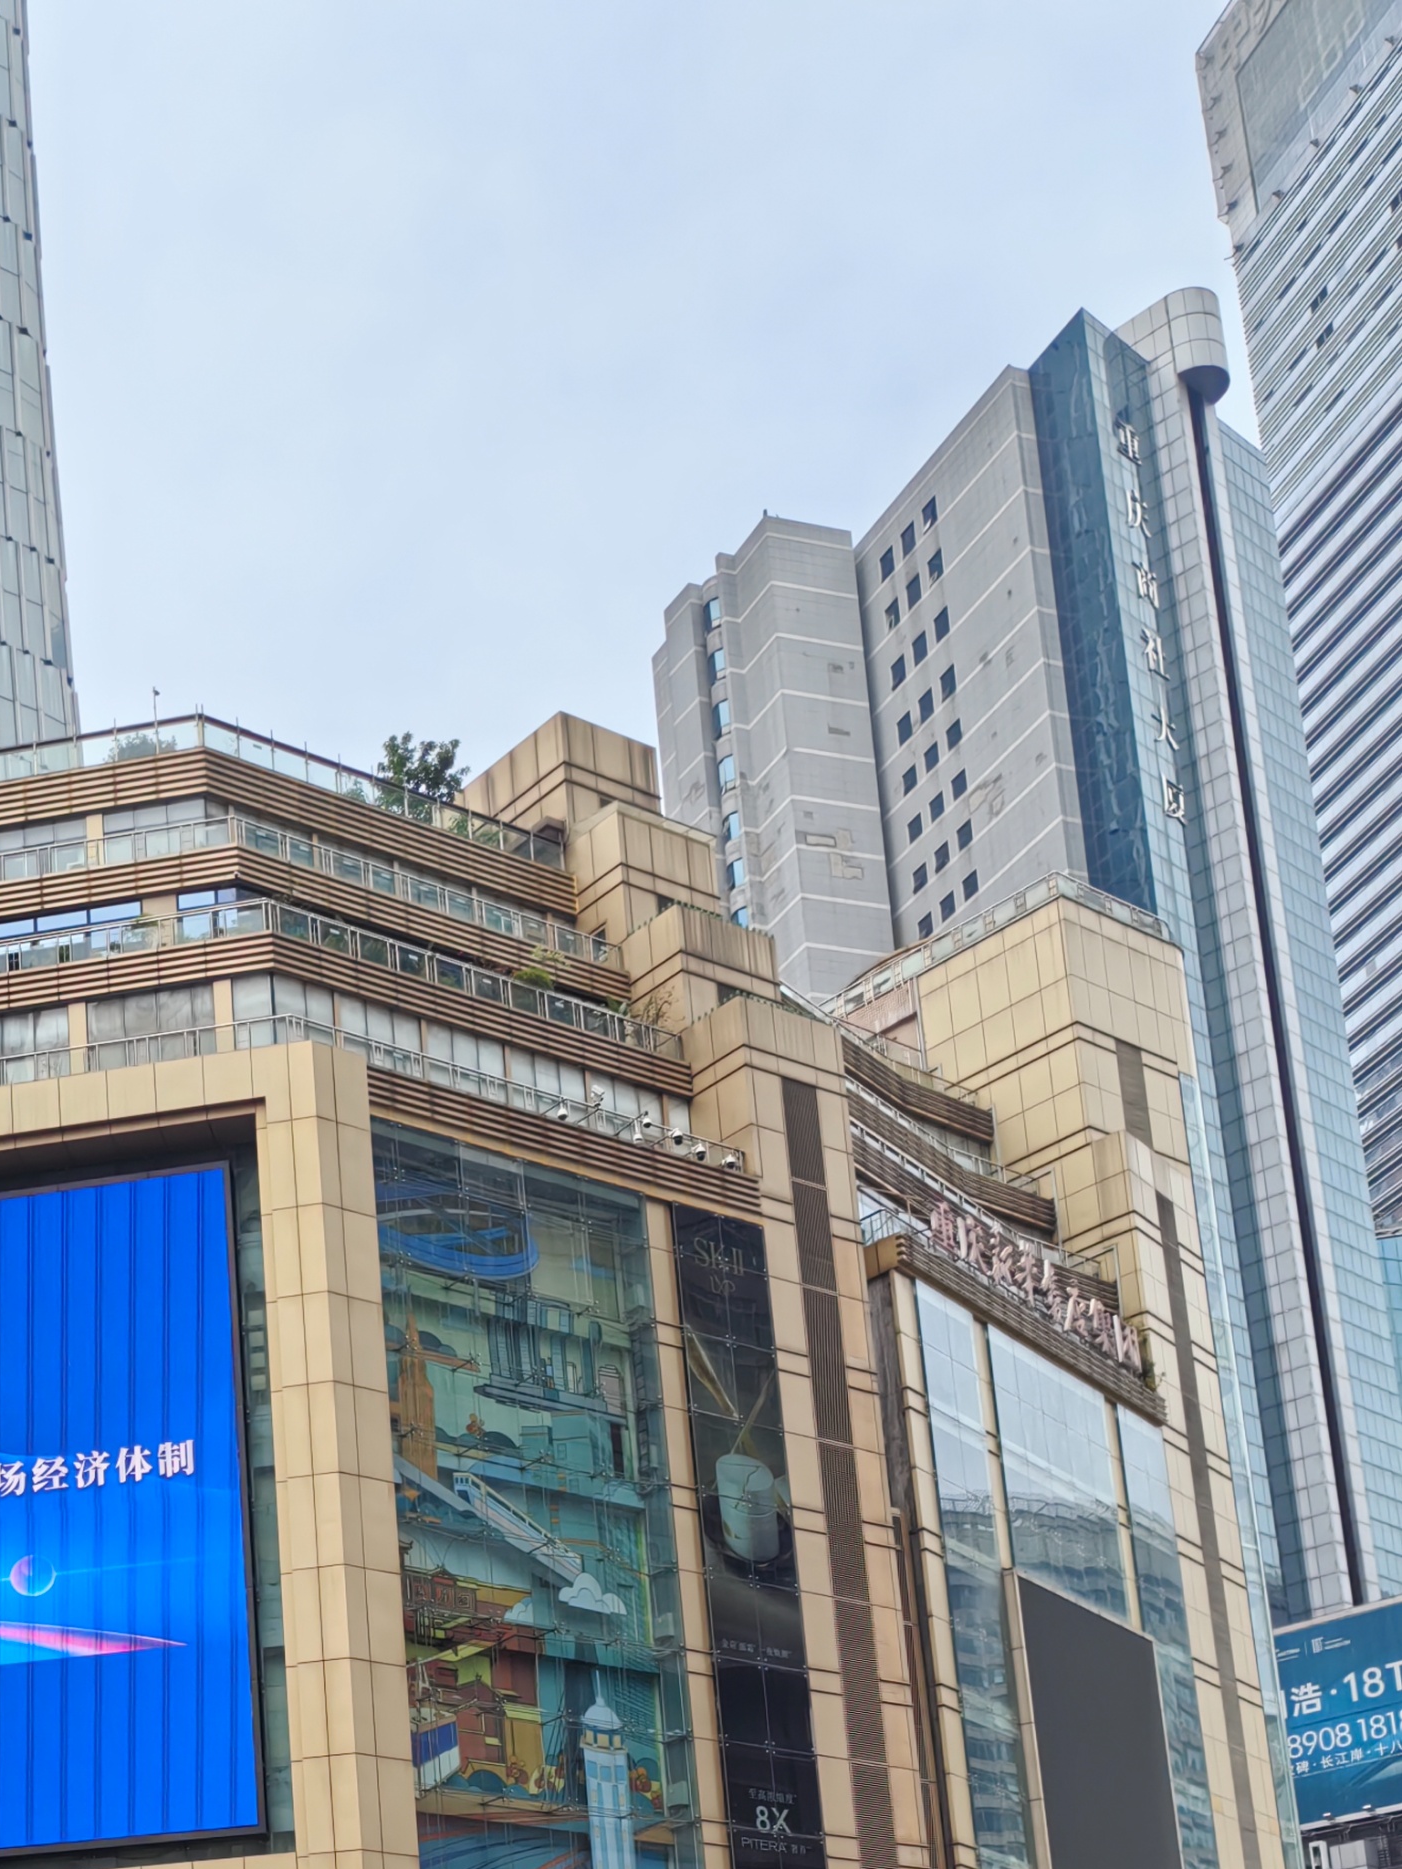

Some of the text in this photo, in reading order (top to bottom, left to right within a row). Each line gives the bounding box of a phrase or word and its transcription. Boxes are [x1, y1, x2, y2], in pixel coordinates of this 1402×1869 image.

[1114, 420, 1187, 827] 重庆商社大厦
[756, 1805, 791, 1836] 8X
